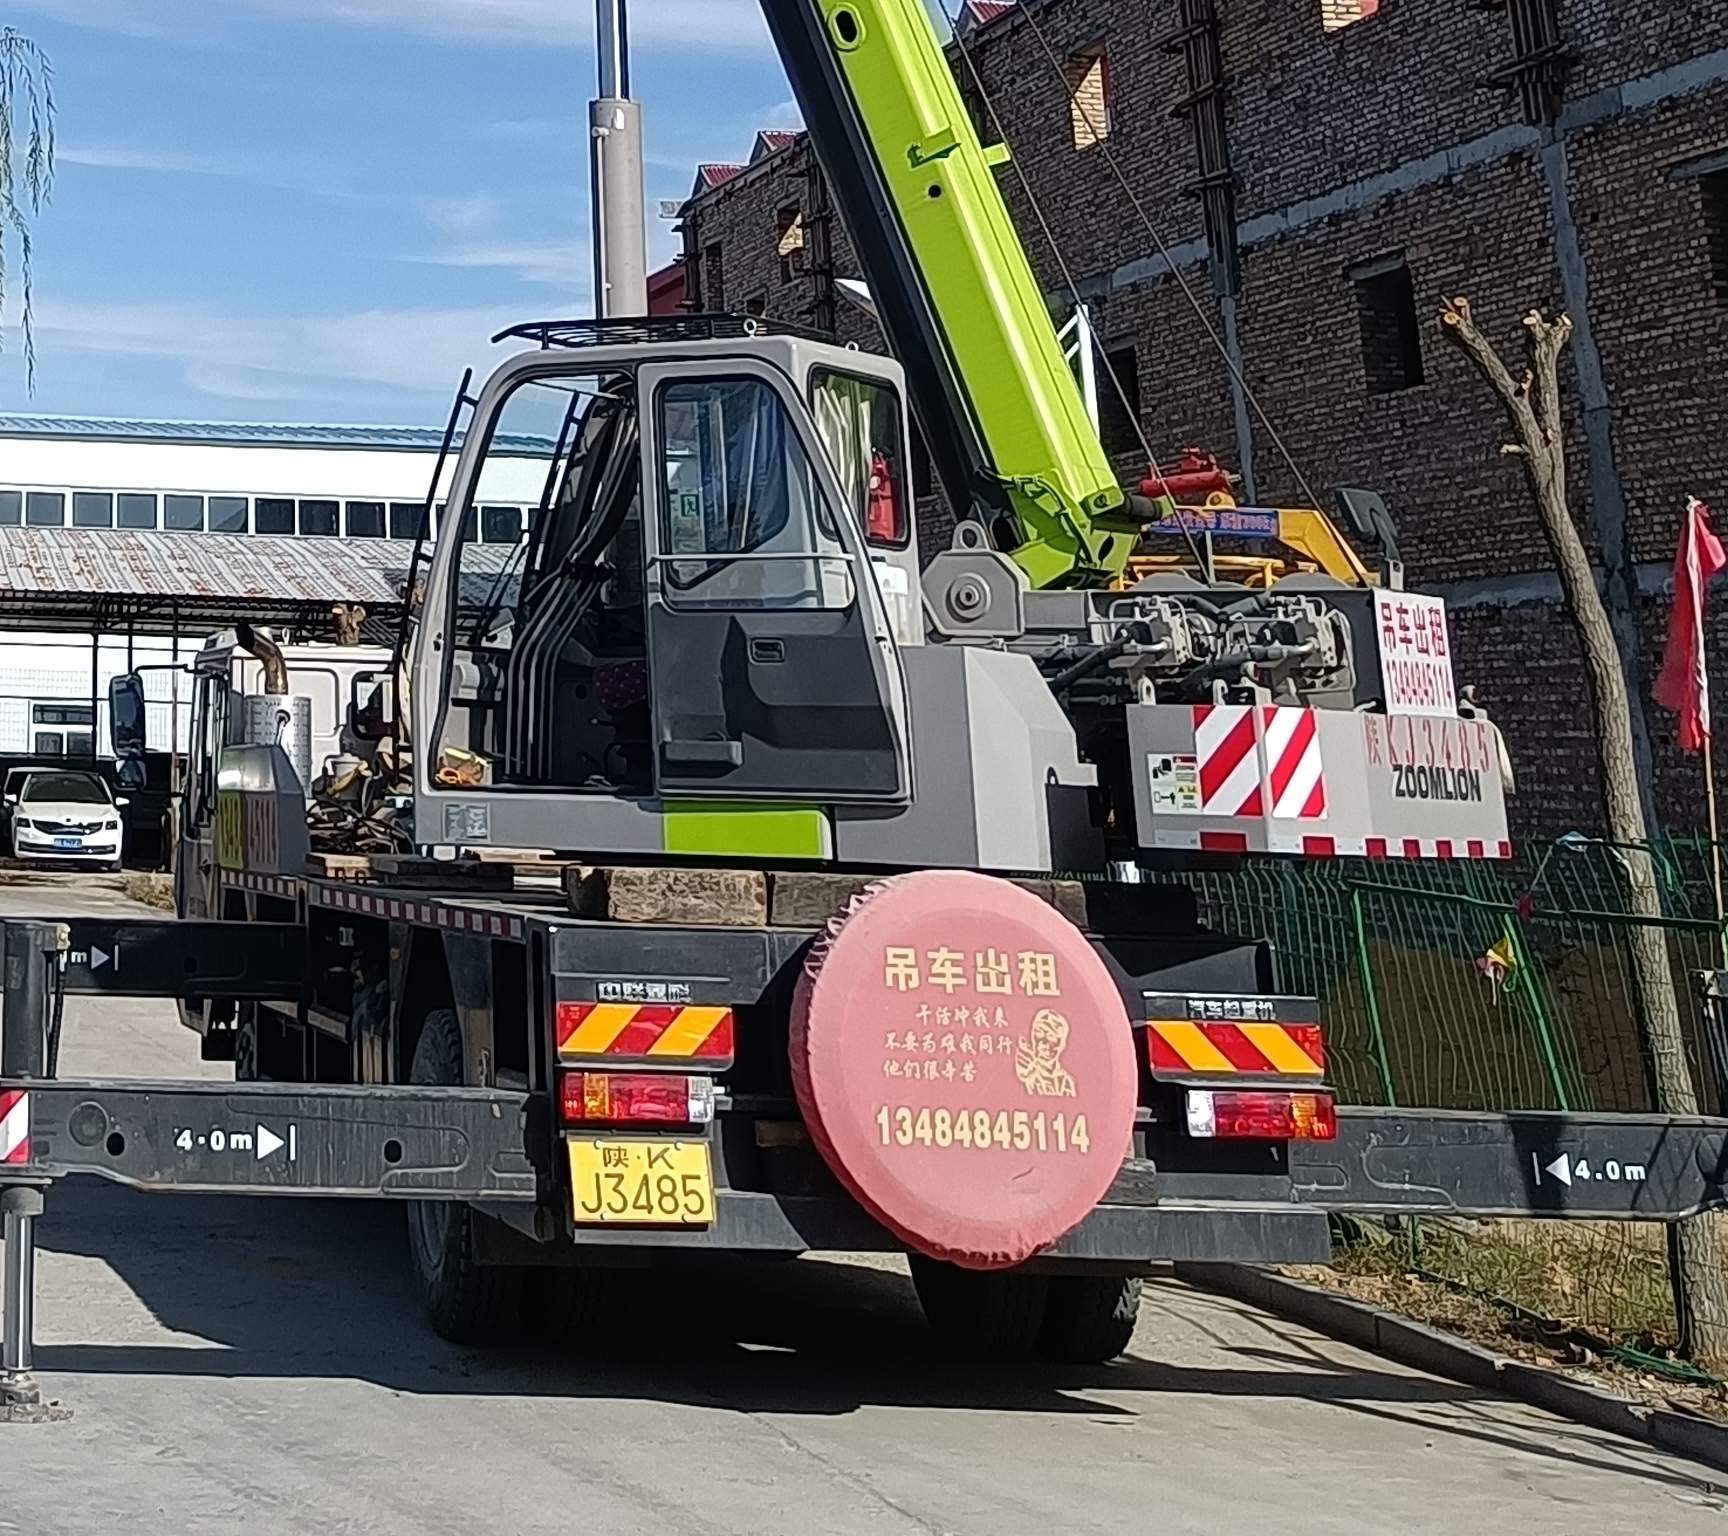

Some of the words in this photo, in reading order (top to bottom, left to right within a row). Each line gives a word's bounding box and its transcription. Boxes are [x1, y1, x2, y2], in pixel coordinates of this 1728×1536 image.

[1379, 601, 1447, 658] 吊车出租
[1386, 659, 1453, 708] 13484845114
[1392, 764, 1482, 802] ZOOMLION
[885, 946, 1061, 996] 吊车出租
[884, 1030, 1014, 1056] 不要为难我同行
[882, 1058, 977, 1083] 他们很辛苦
[877, 1105, 1091, 1154] 13484845114
[581, 1172, 705, 1215] J3485
